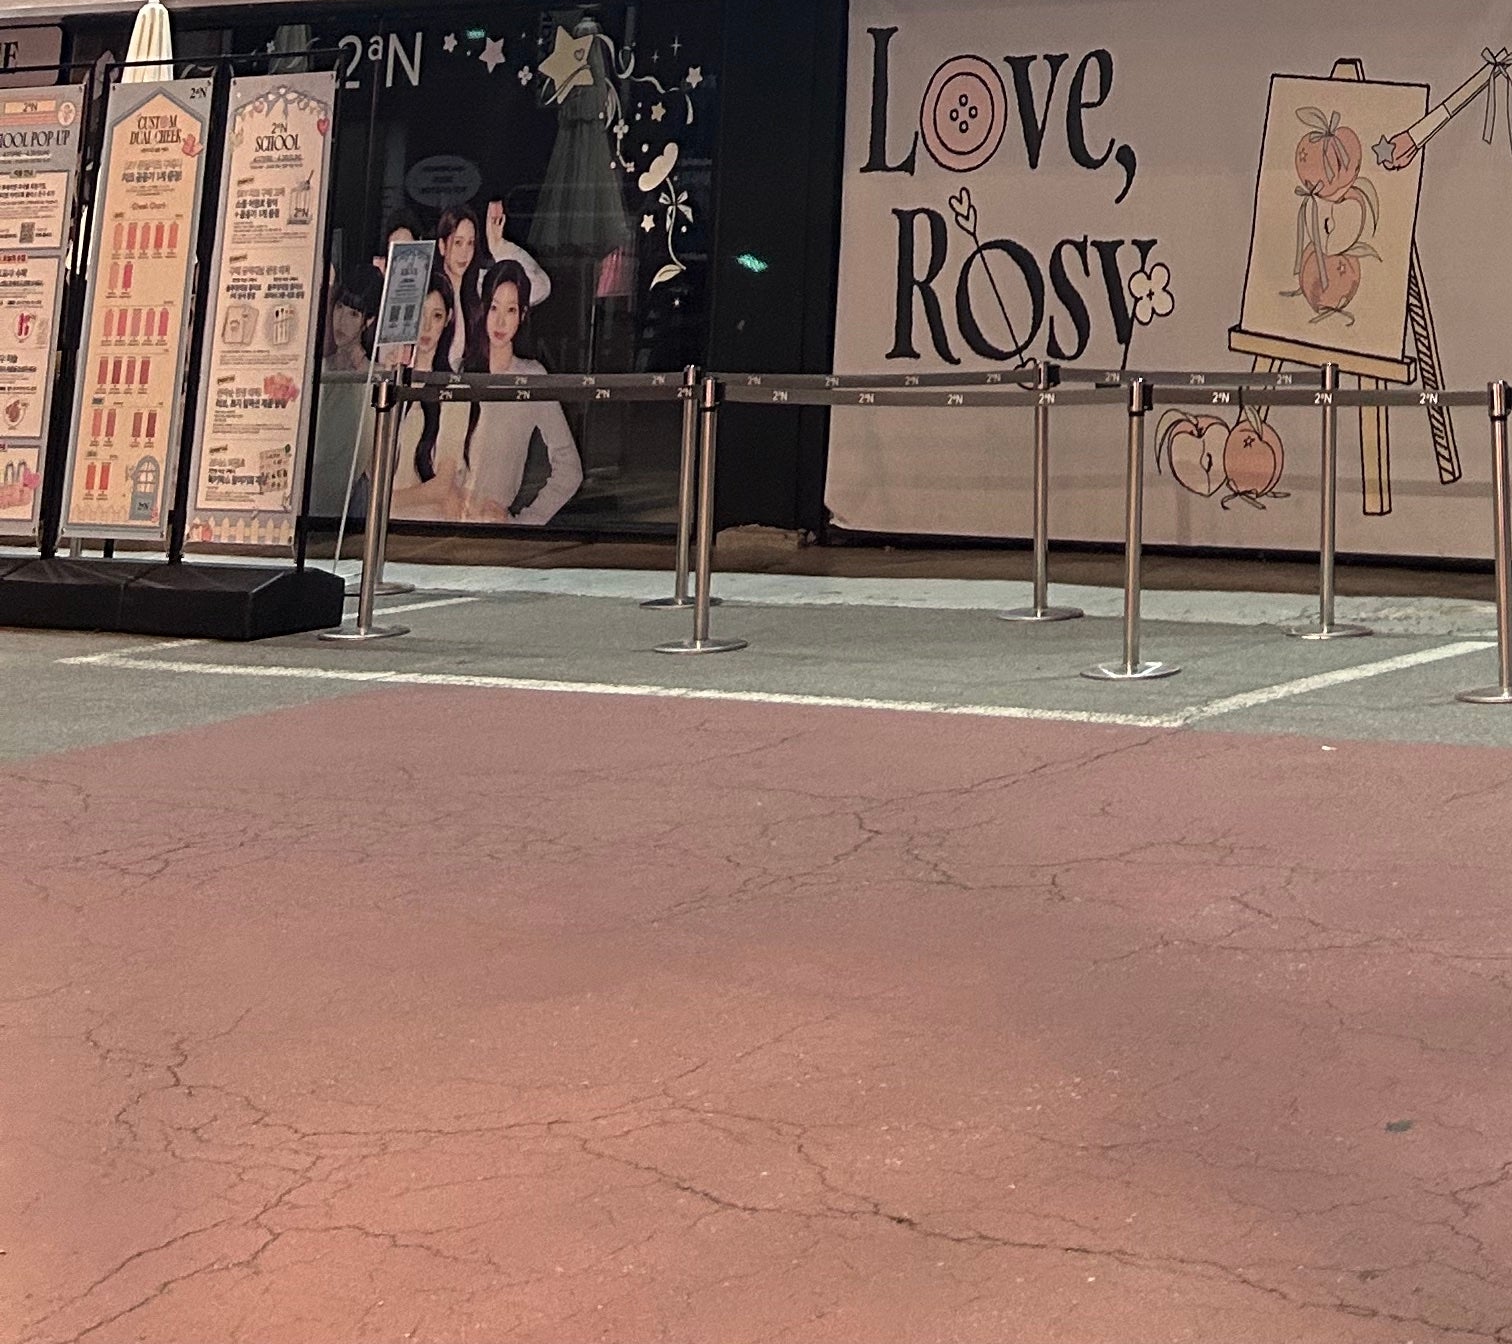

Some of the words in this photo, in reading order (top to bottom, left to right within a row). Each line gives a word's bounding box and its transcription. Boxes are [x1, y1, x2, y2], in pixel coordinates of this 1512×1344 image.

[333, 32, 422, 87] 2aN
[31, 130, 54, 147] POP
[129, 131, 152, 146] DUAL
[255, 134, 301, 152] SCHOOL
